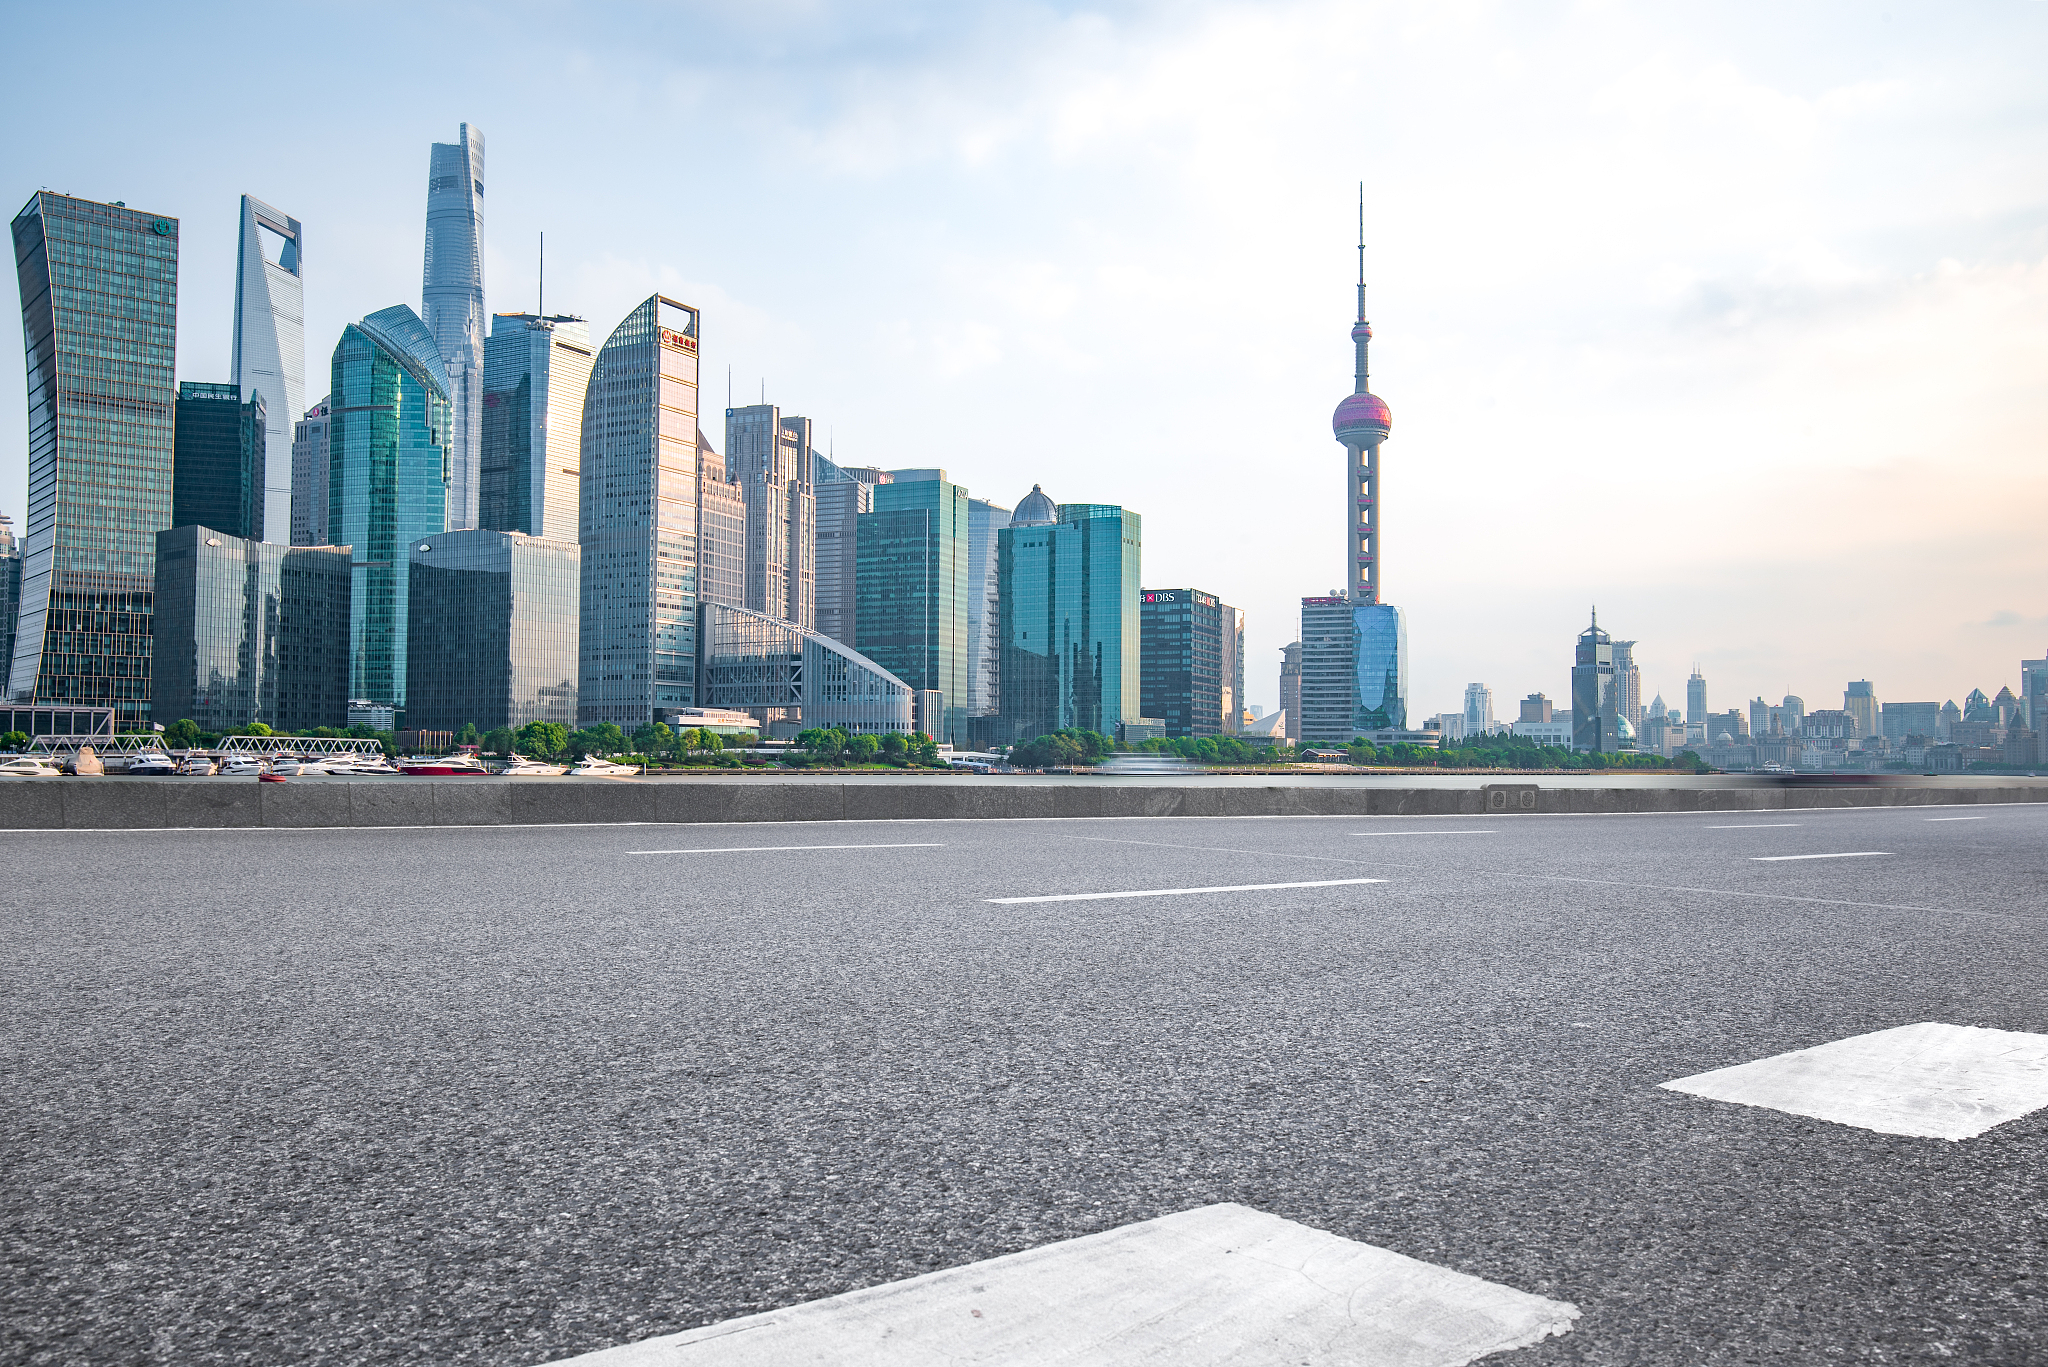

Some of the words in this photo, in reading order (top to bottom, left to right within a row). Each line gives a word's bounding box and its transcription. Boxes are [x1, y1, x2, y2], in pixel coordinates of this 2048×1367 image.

[192, 392, 238, 401] 中国民生银行
[1155, 592, 1175, 603] DBS
